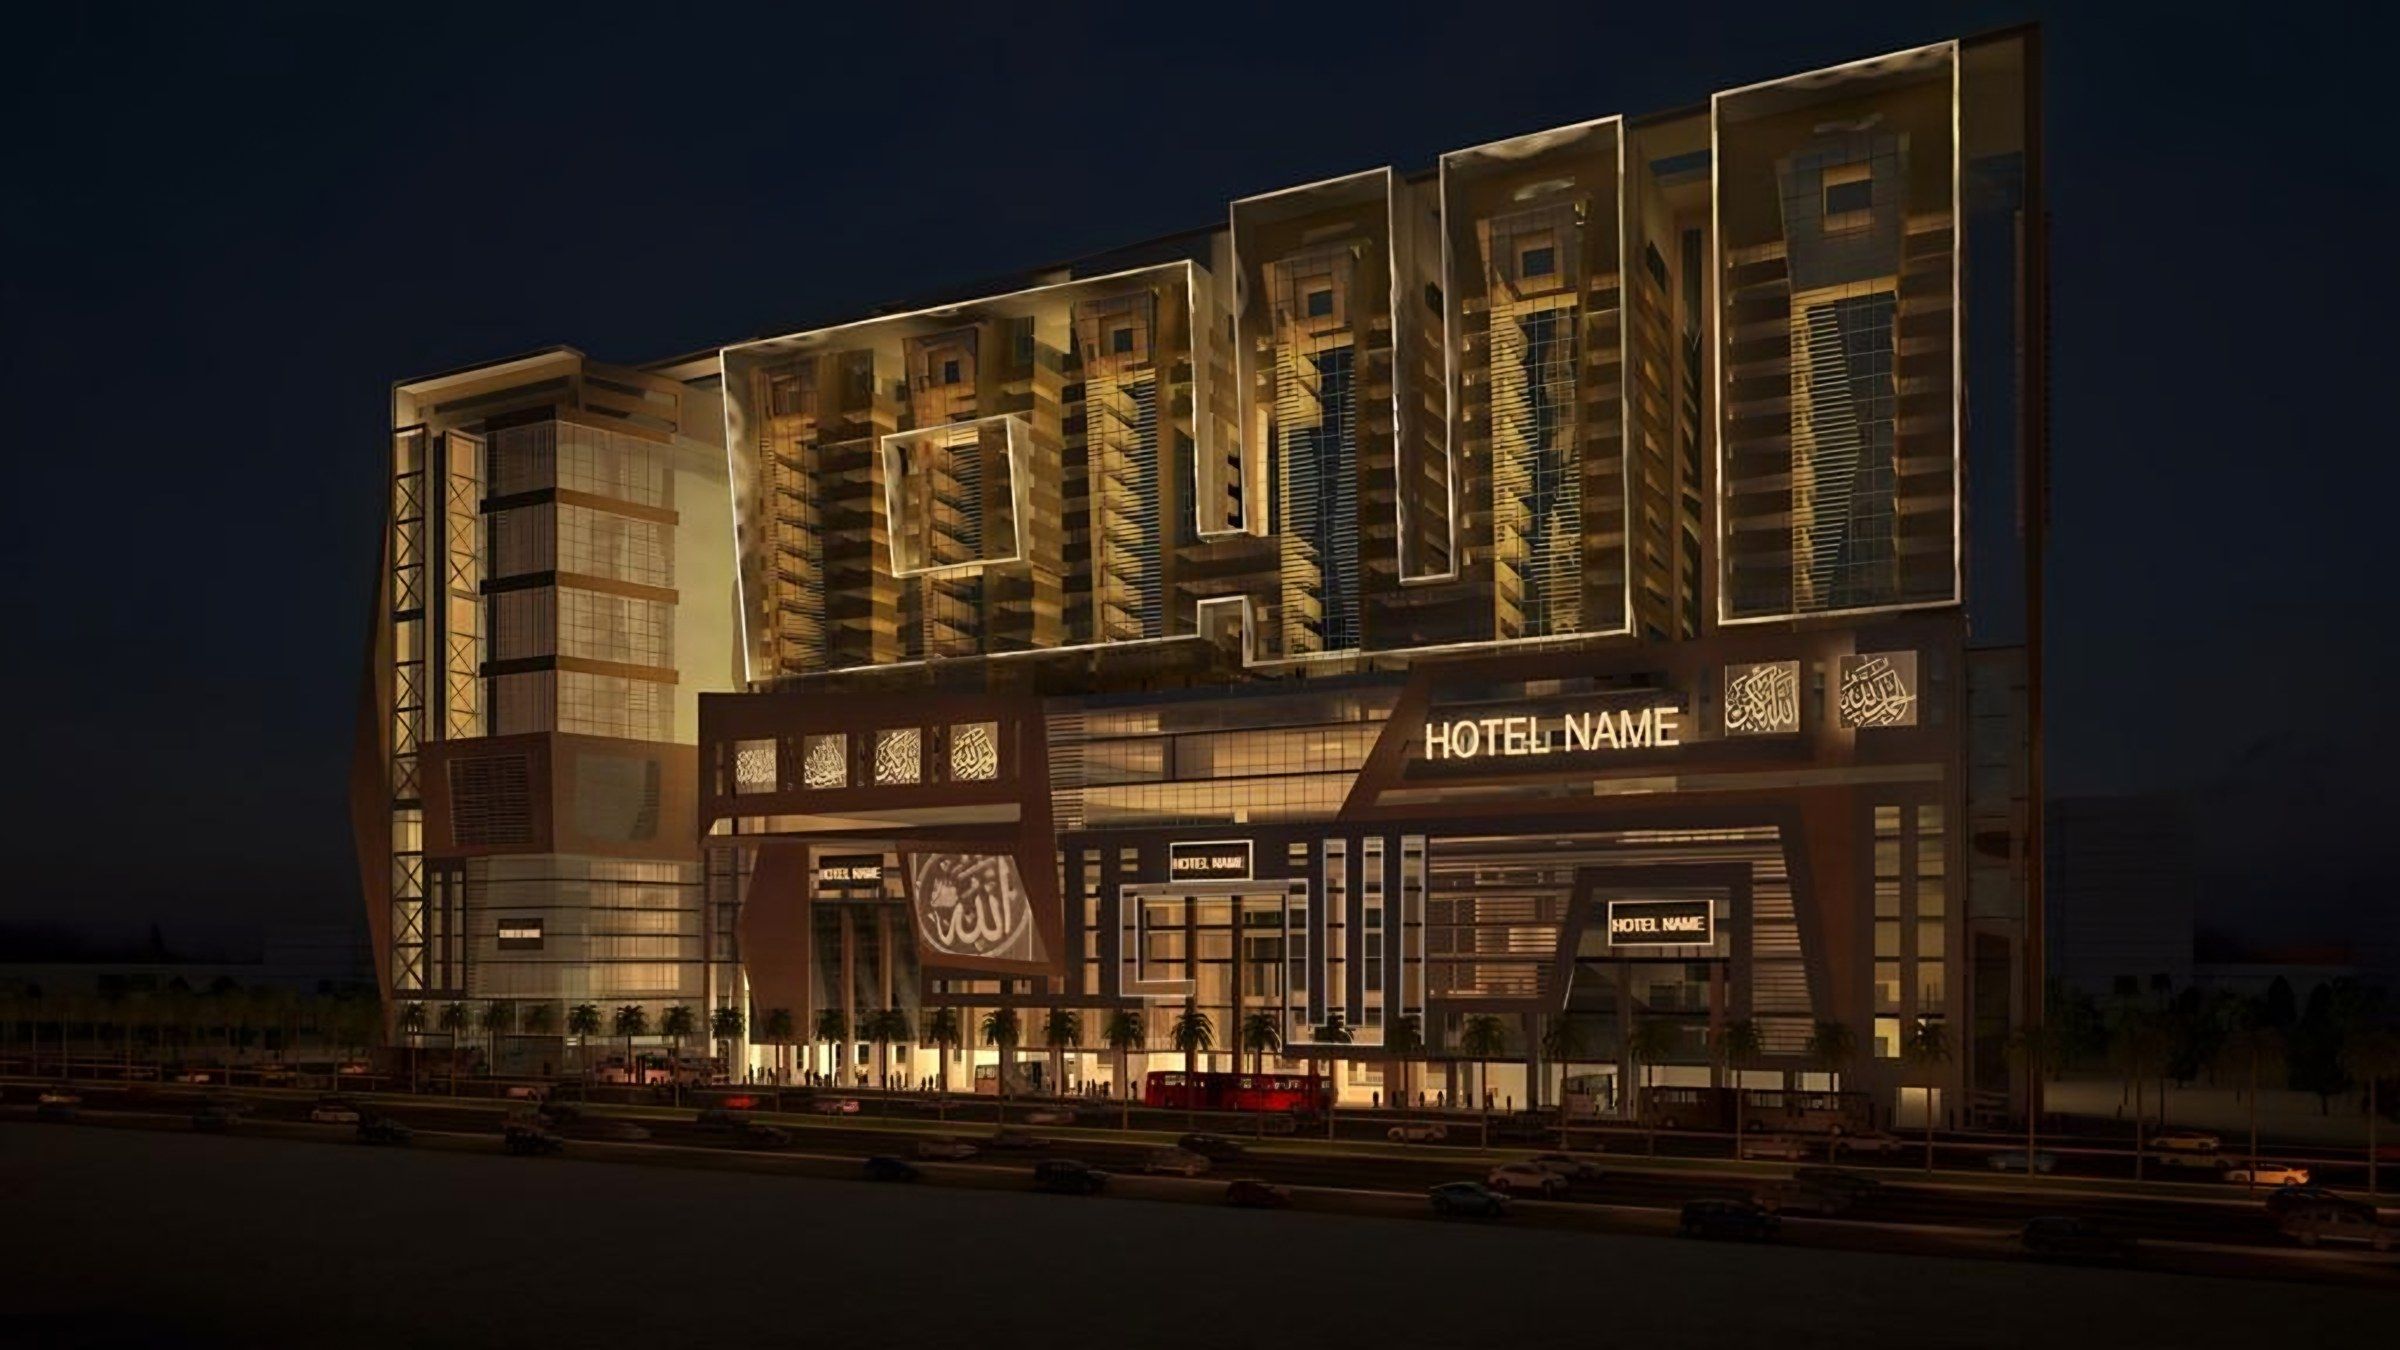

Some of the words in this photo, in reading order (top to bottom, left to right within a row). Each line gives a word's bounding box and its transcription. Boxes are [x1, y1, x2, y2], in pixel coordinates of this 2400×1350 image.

[1425, 716, 1551, 760] HOTEL
[1564, 706, 1680, 752] NAME
[1612, 918, 1660, 933] HOTEL
[1662, 916, 1706, 931] NAME
